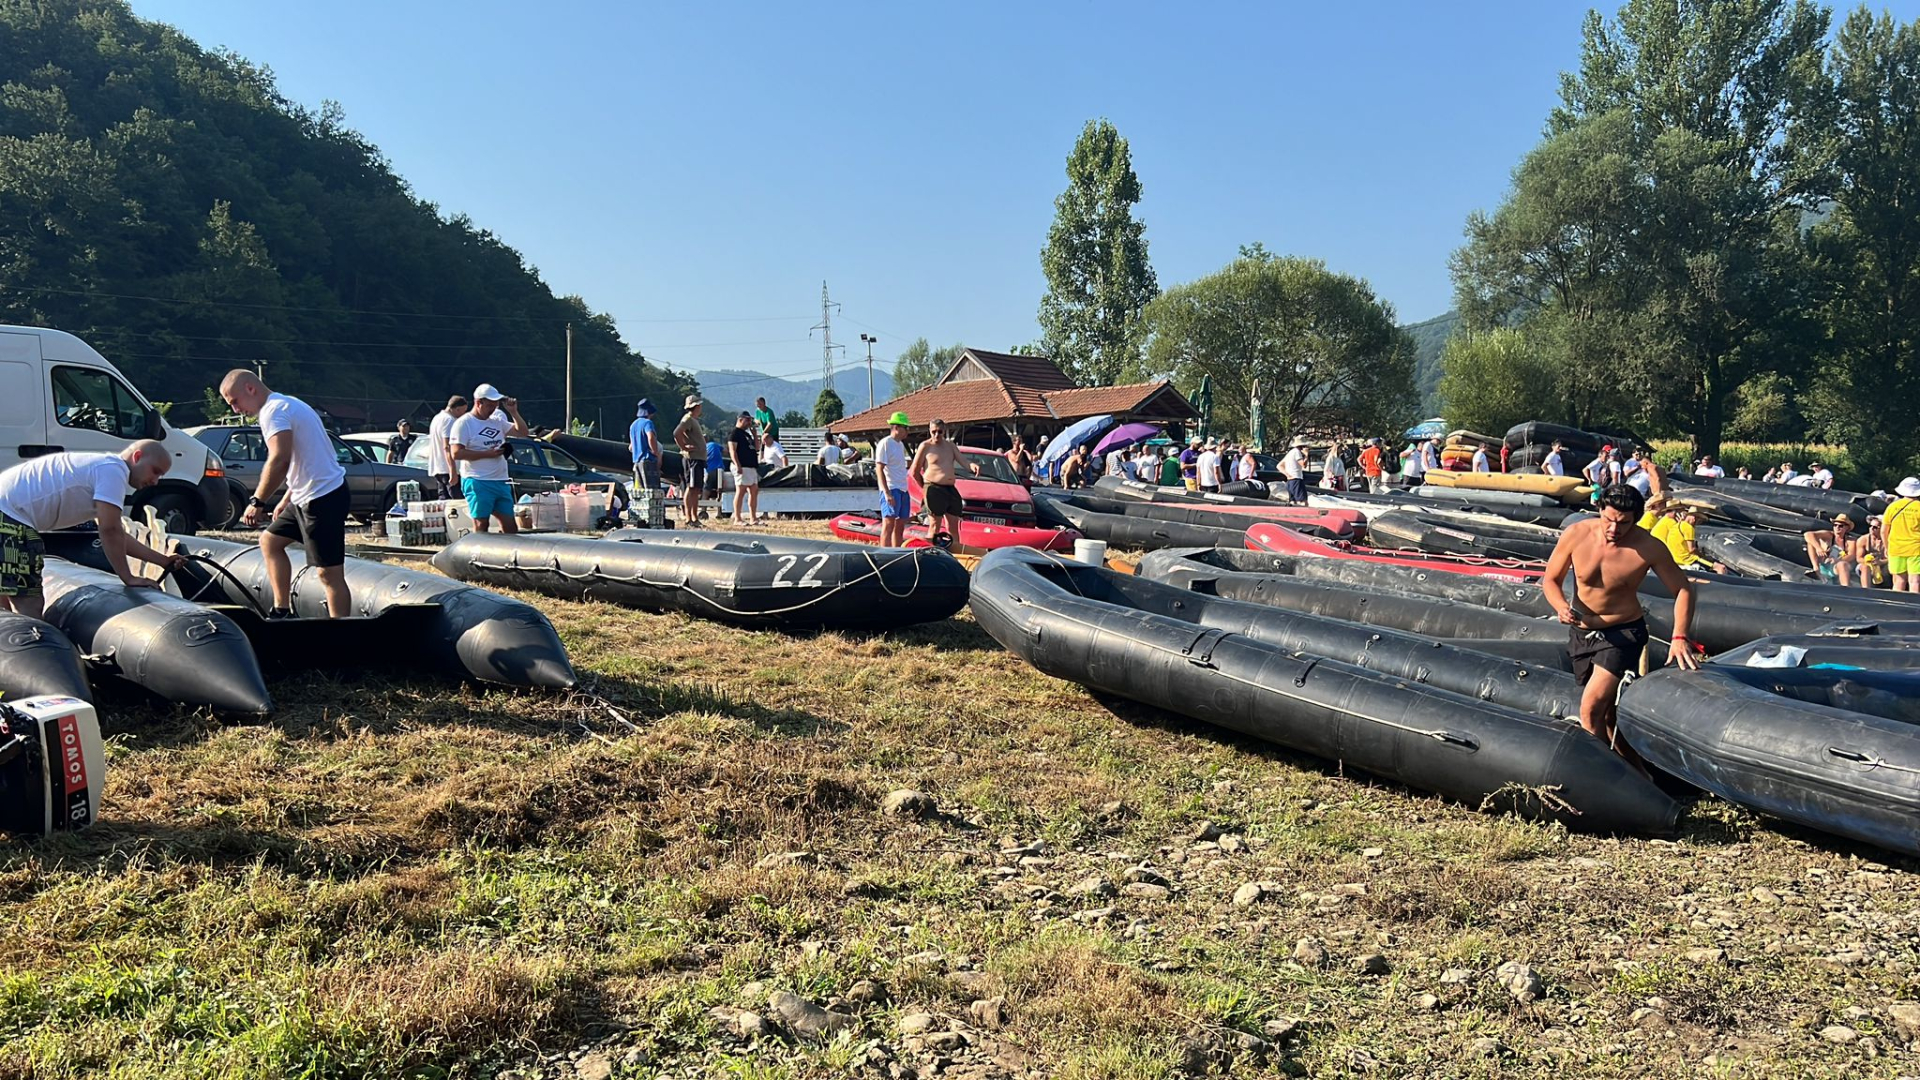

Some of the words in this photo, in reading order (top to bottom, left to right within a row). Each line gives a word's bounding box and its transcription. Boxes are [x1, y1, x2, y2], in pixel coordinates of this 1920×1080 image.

[772, 553, 830, 589] 22
[62, 722, 83, 784] TOMOS
[70, 799, 87, 821] 18
